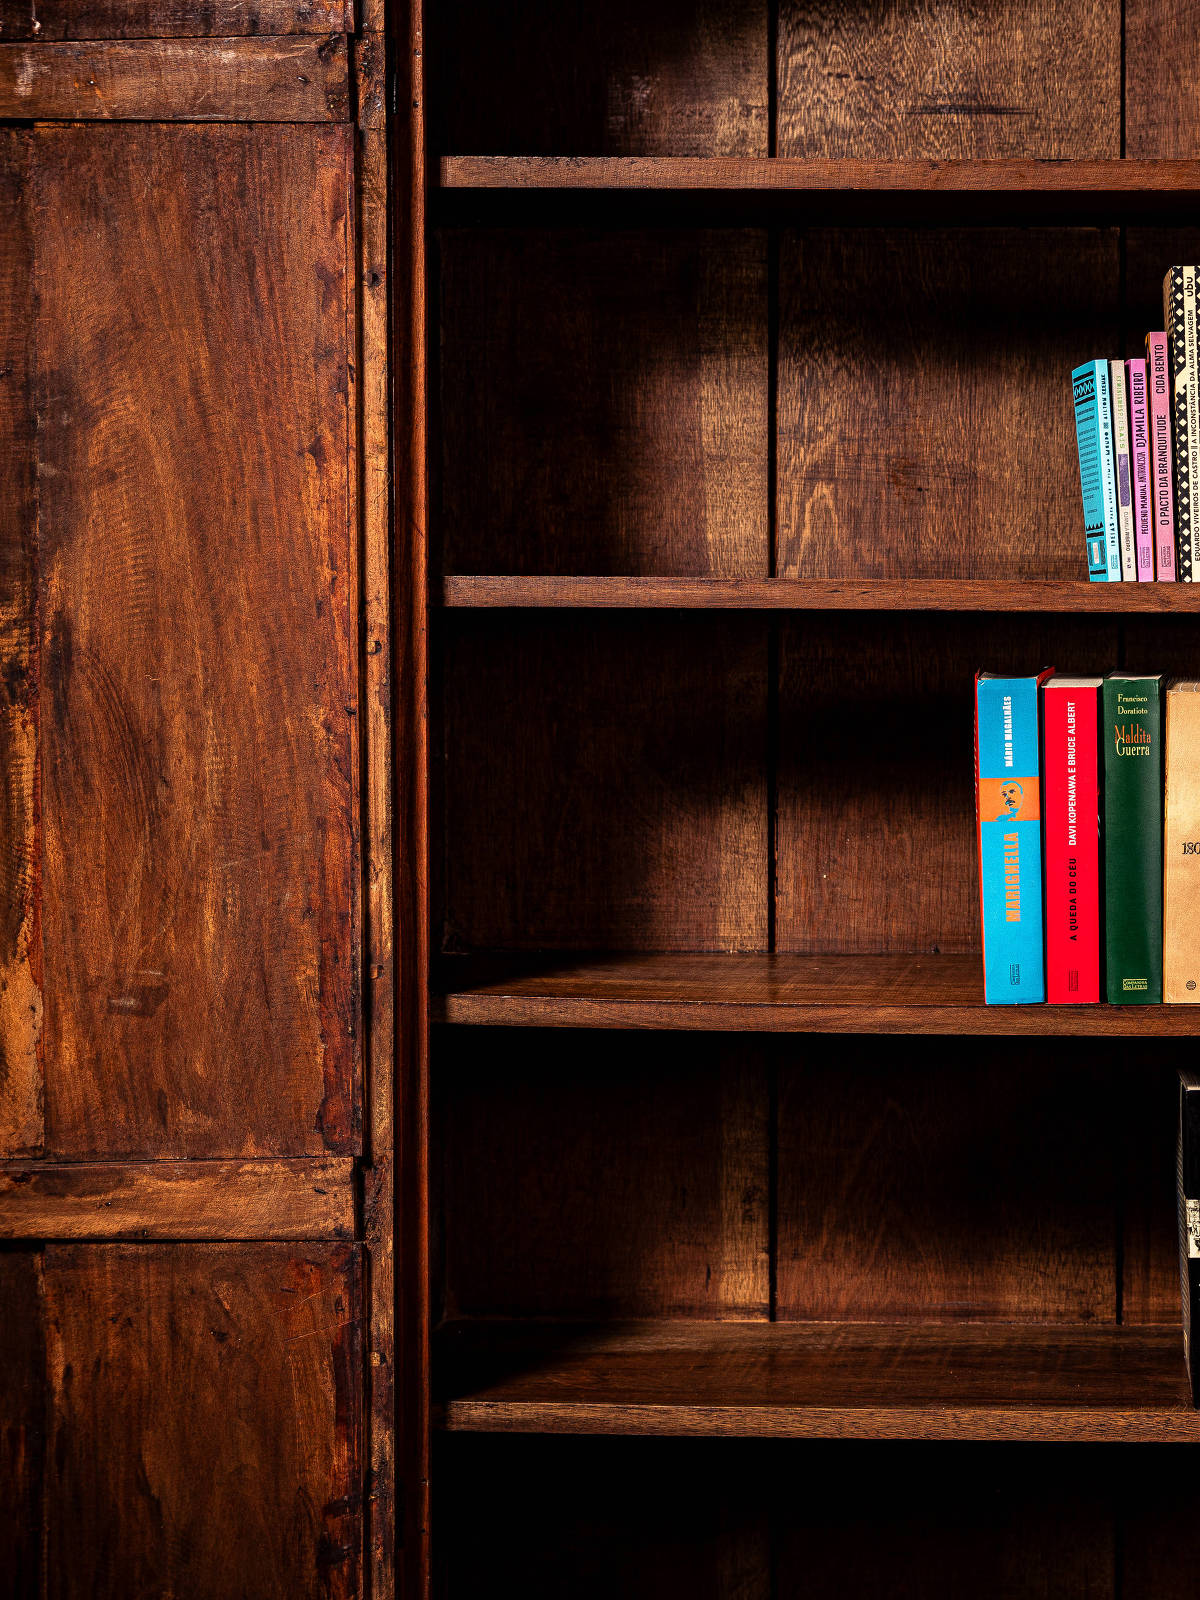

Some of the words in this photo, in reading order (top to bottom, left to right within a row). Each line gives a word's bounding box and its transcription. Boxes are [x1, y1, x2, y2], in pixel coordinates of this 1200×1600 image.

[1184, 276, 1194, 297] ubu
[1187, 310, 1195, 347] SELVAGEM
[1154, 345, 1164, 372] BENTO
[1133, 372, 1145, 405] RIBEIRO
[1156, 374, 1165, 394] CIDA
[1188, 383, 1198, 437] INCONSTÂNCIA
[1135, 408, 1147, 448] DJAMILA
[1157, 415, 1168, 475] BRANQUITUDE
[1136, 452, 1147, 483] ANTIRRACISTA
[1191, 451, 1199, 479] CASTRO
[1158, 476, 1168, 488] DA
[1192, 481, 1199, 491] DE
[1139, 485, 1148, 509] MANUAL
[1159, 490, 1169, 517] PACTO
[1192, 493, 1200, 525] VIVEIROS
[1140, 510, 1149, 535] PEQUENO
[1117, 693, 1148, 703] Francisco
[1117, 706, 1149, 715] Doratioto
[1002, 696, 1013, 741] MAGALHÃES
[1067, 701, 1076, 735] ALBERT
[1114, 723, 1152, 745] Maldita
[1116, 737, 1150, 757] Guerra
[1003, 742, 1013, 768] MÁRIO
[1068, 736, 1076, 765] BRUCE
[1068, 774, 1077, 824] KOPENAWA
[1069, 825, 1077, 846] DAVI
[1004, 832, 1021, 923] MARIGHELLA
[1067, 858, 1077, 878] CÉU
[1069, 881, 1077, 894] DO
[1069, 898, 1078, 931] QUEDA
